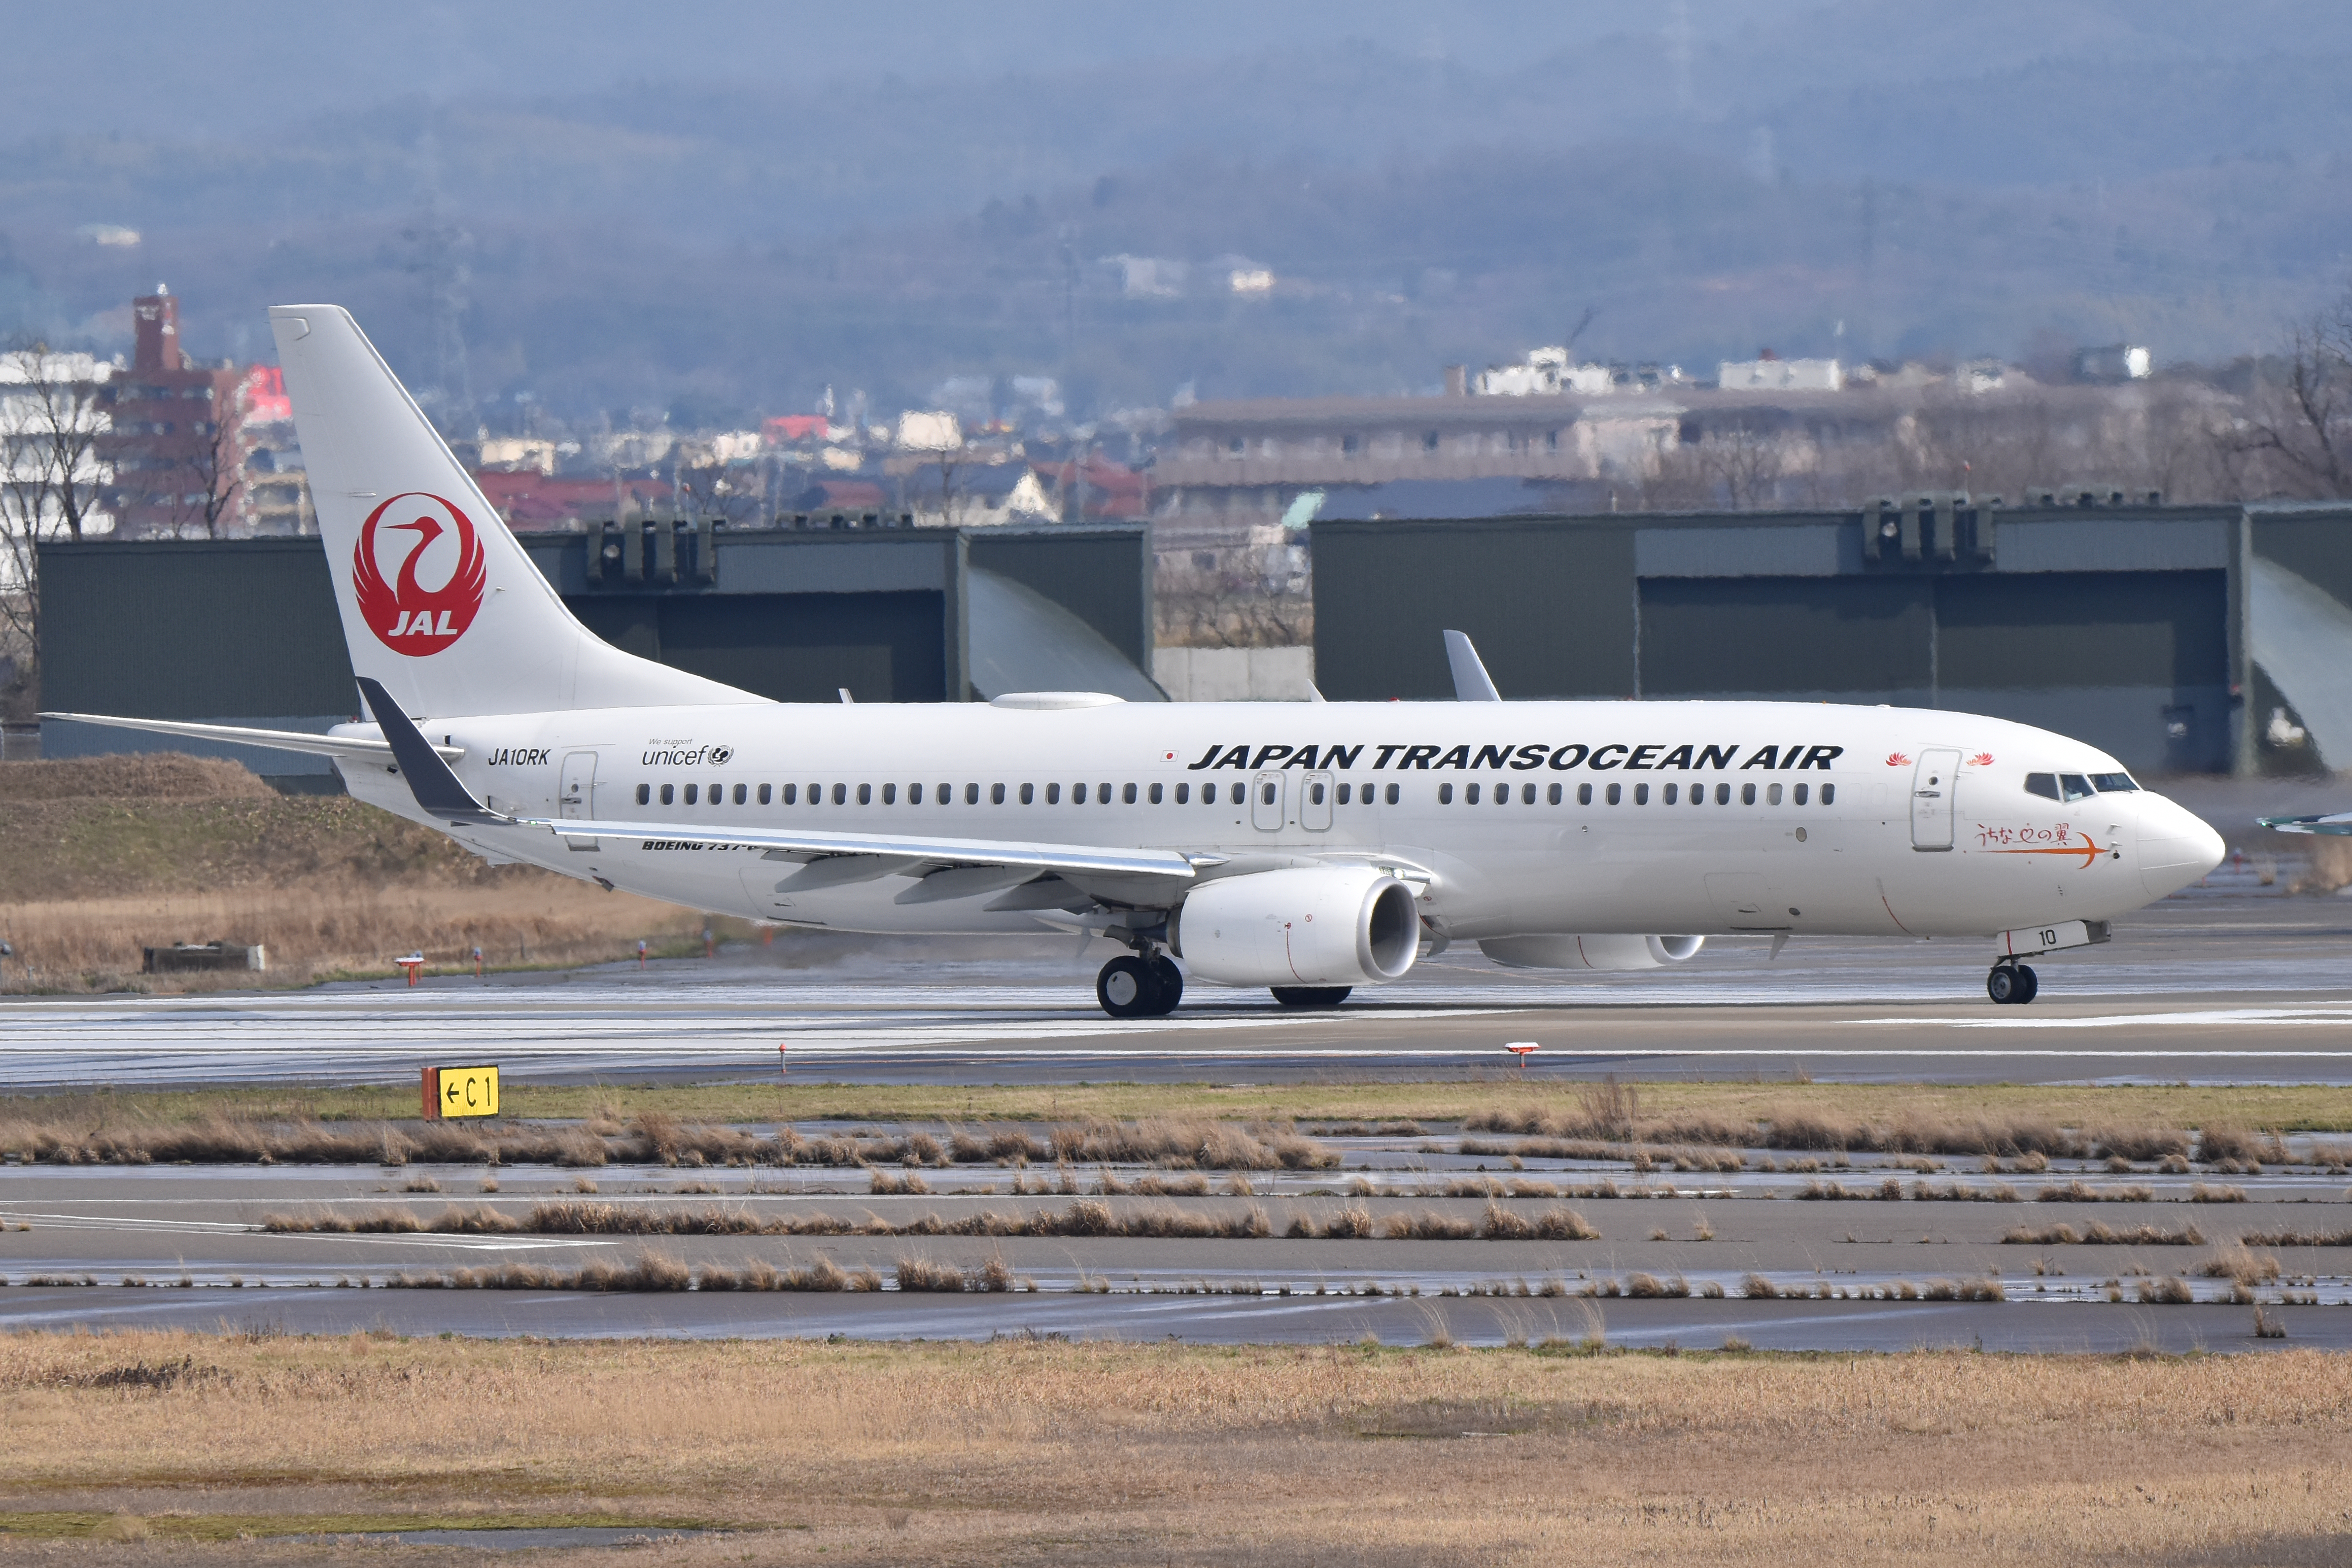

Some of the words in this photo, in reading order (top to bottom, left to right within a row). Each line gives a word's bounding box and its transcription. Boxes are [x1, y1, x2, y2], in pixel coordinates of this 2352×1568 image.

[388, 610, 458, 636] JAL
[663, 738, 693, 747] support
[488, 748, 551, 765] JA10RK
[642, 745, 709, 765] unicef
[1187, 744, 1365, 770] JAPAN
[1372, 744, 1741, 770] TRANSOCEAN
[1738, 744, 1844, 770] AIR
[642, 841, 704, 851] BOEING
[2039, 929, 2056, 946] 10
[466, 1076, 491, 1107] C1
